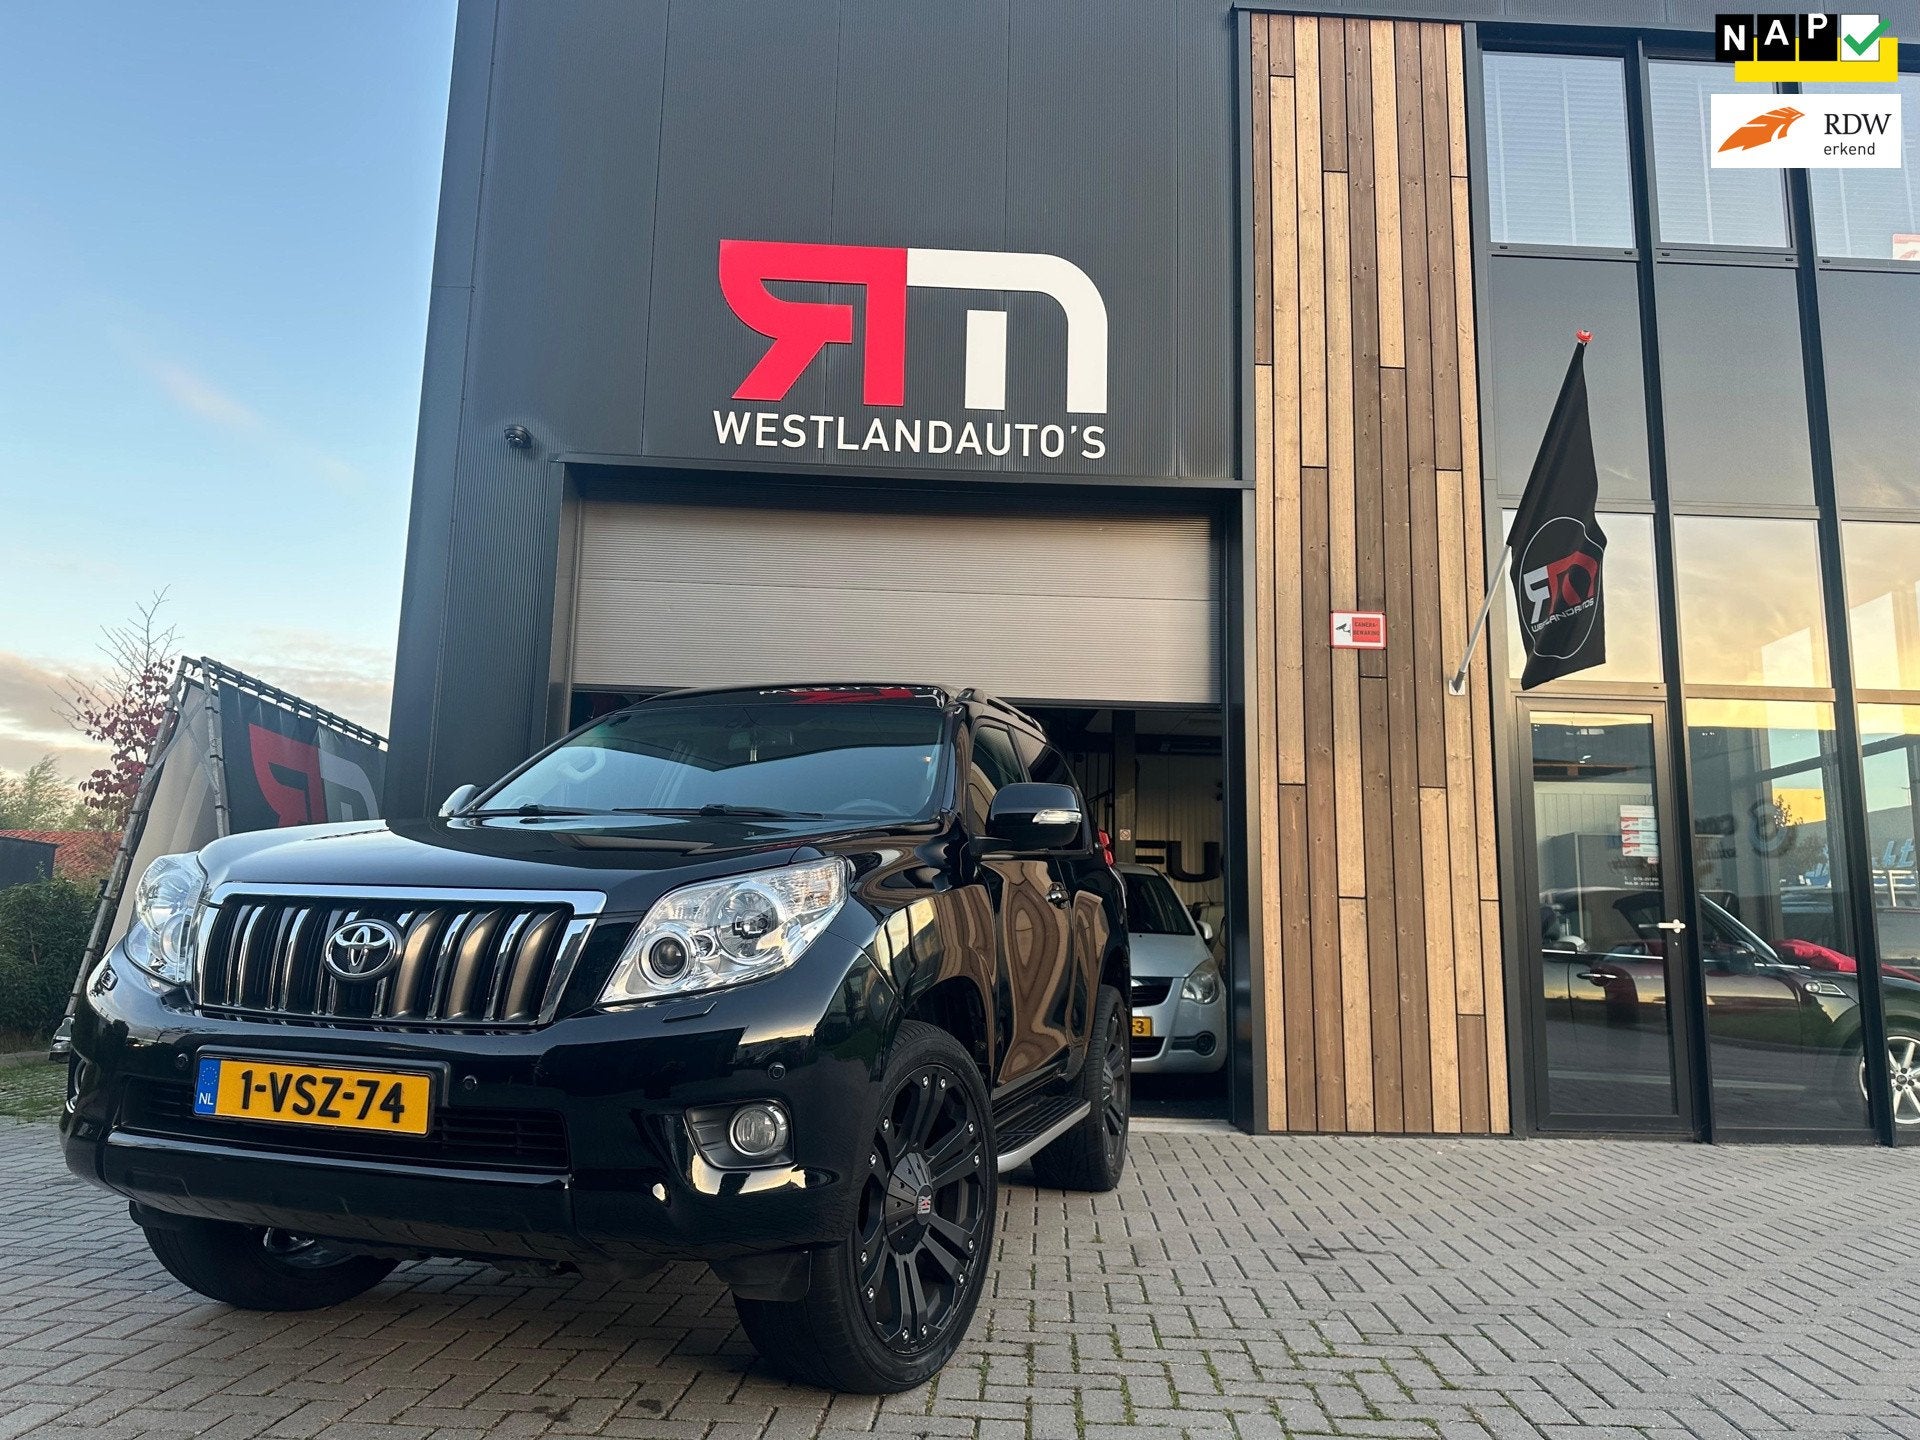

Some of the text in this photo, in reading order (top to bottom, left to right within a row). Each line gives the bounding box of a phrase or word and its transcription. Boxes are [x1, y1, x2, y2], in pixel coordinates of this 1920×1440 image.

[713, 410, 1107, 460] WESTLANDAUTO'S
[198, 1092, 214, 1105] NL
[241, 1070, 405, 1124] 1-VSZ-74
